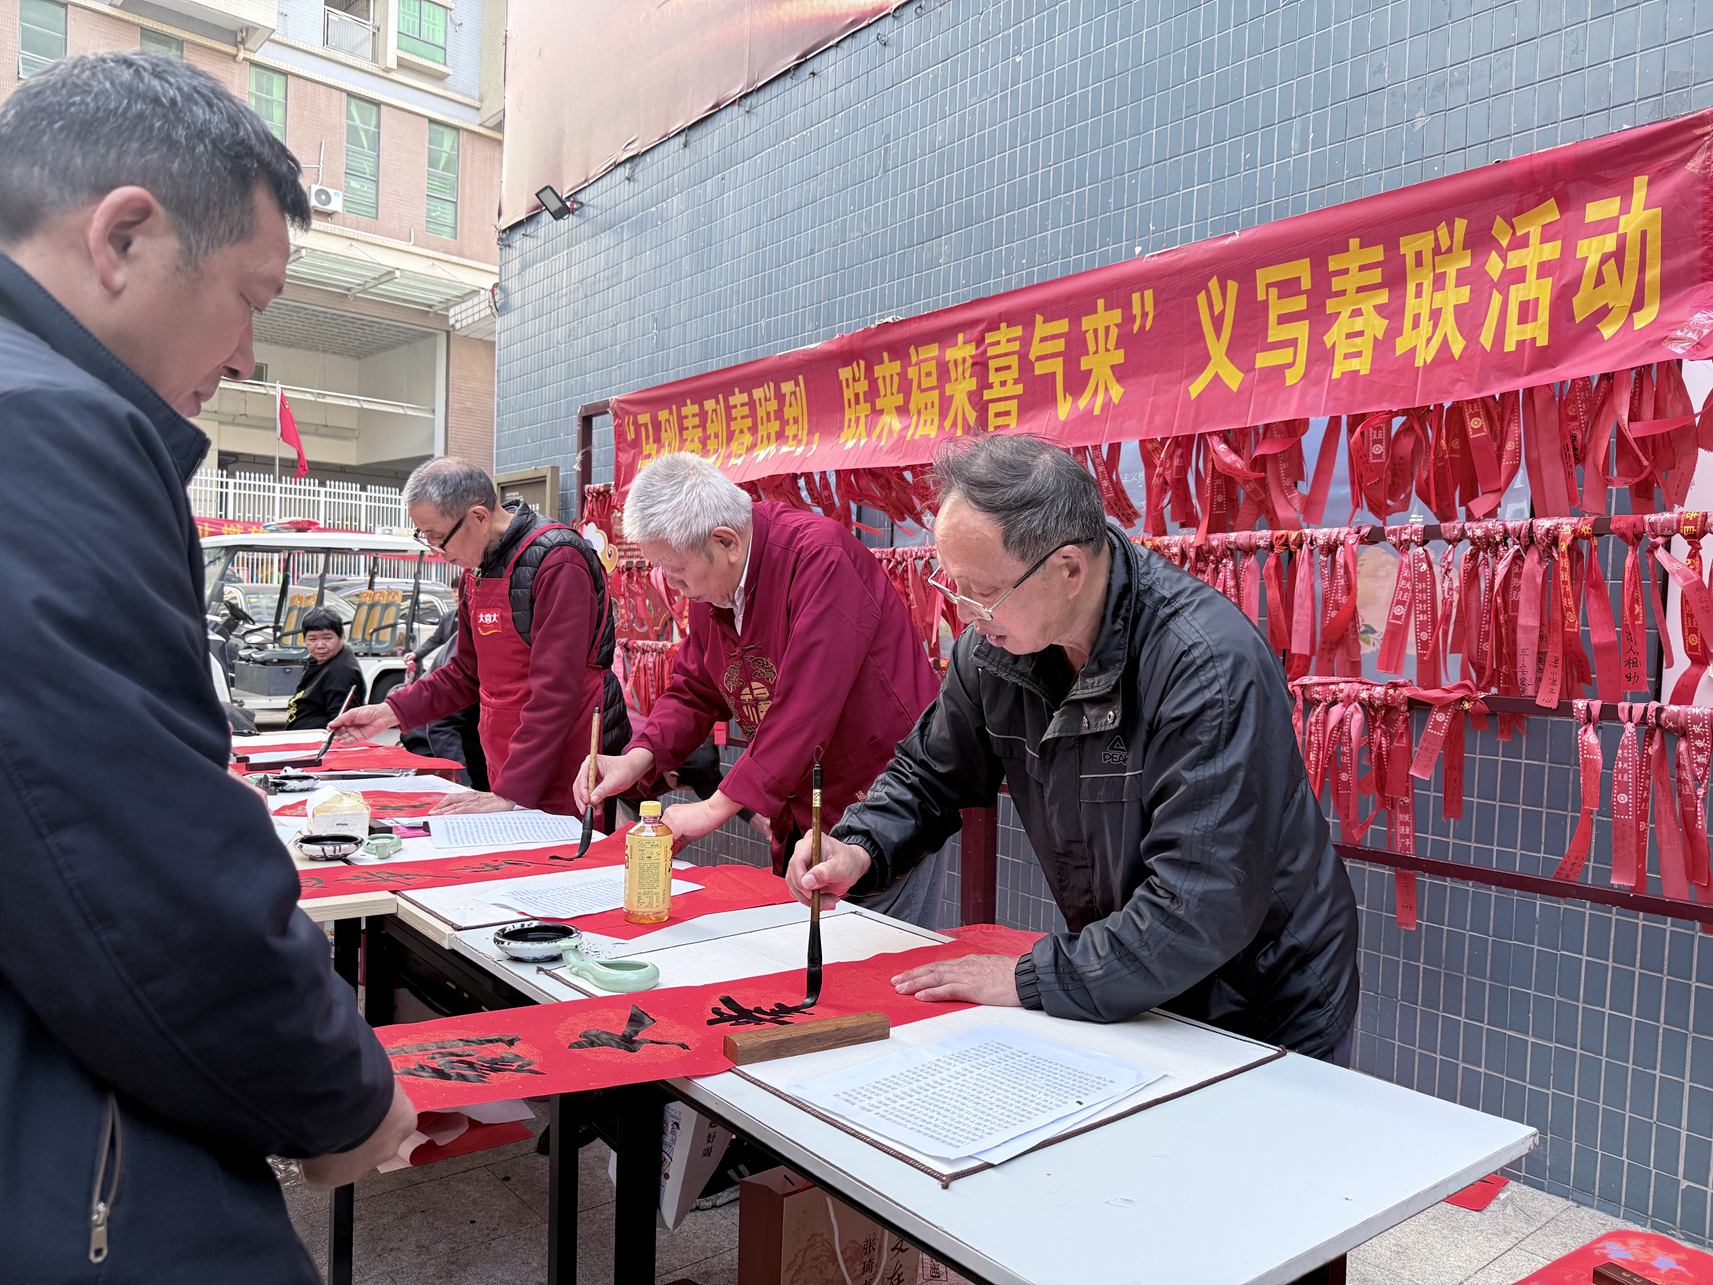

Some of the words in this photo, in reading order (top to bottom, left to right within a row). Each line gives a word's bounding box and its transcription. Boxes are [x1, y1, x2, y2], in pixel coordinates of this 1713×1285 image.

[1188, 175, 1662, 400] 义写春联活动
